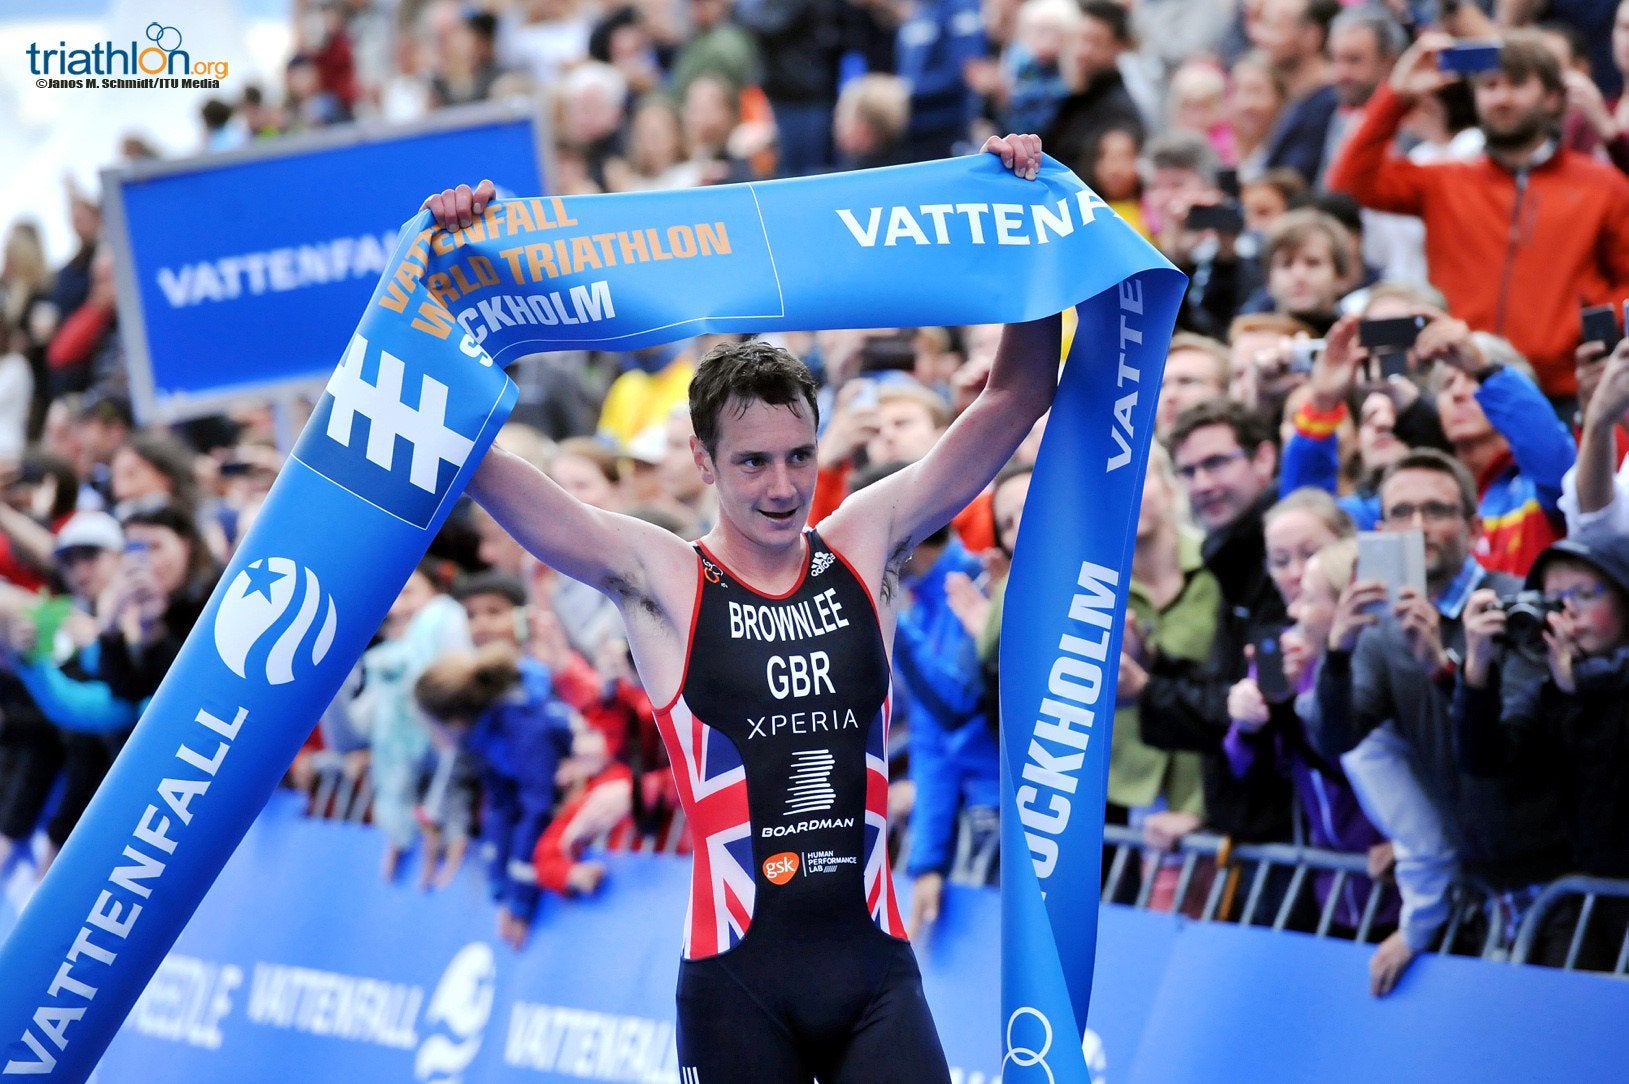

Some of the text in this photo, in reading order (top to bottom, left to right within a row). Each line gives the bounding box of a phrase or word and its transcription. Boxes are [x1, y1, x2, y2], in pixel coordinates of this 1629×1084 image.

[836, 189, 1121, 247] VATTENF
[156, 229, 400, 308] VATTENFA
[500, 222, 732, 285] TRIATHLON
[459, 279, 616, 368] SCKHOLM
[1106, 278, 1144, 473] VATTE
[811, 552, 836, 577] adidas
[728, 587, 849, 641] BROWNLEE
[766, 650, 836, 700] GBR
[747, 709, 859, 740] XPERIA
[1015, 561, 1120, 901] OCKHOLM
[761, 818, 854, 837] BOARDMAN
[765, 856, 795, 879] gsk
[807, 850, 833, 859] HUMAN
[808, 856, 857, 865] PERFORMANCE
[809, 864, 823, 873] LAB
[2, 706, 249, 1075] VATTENFALL
